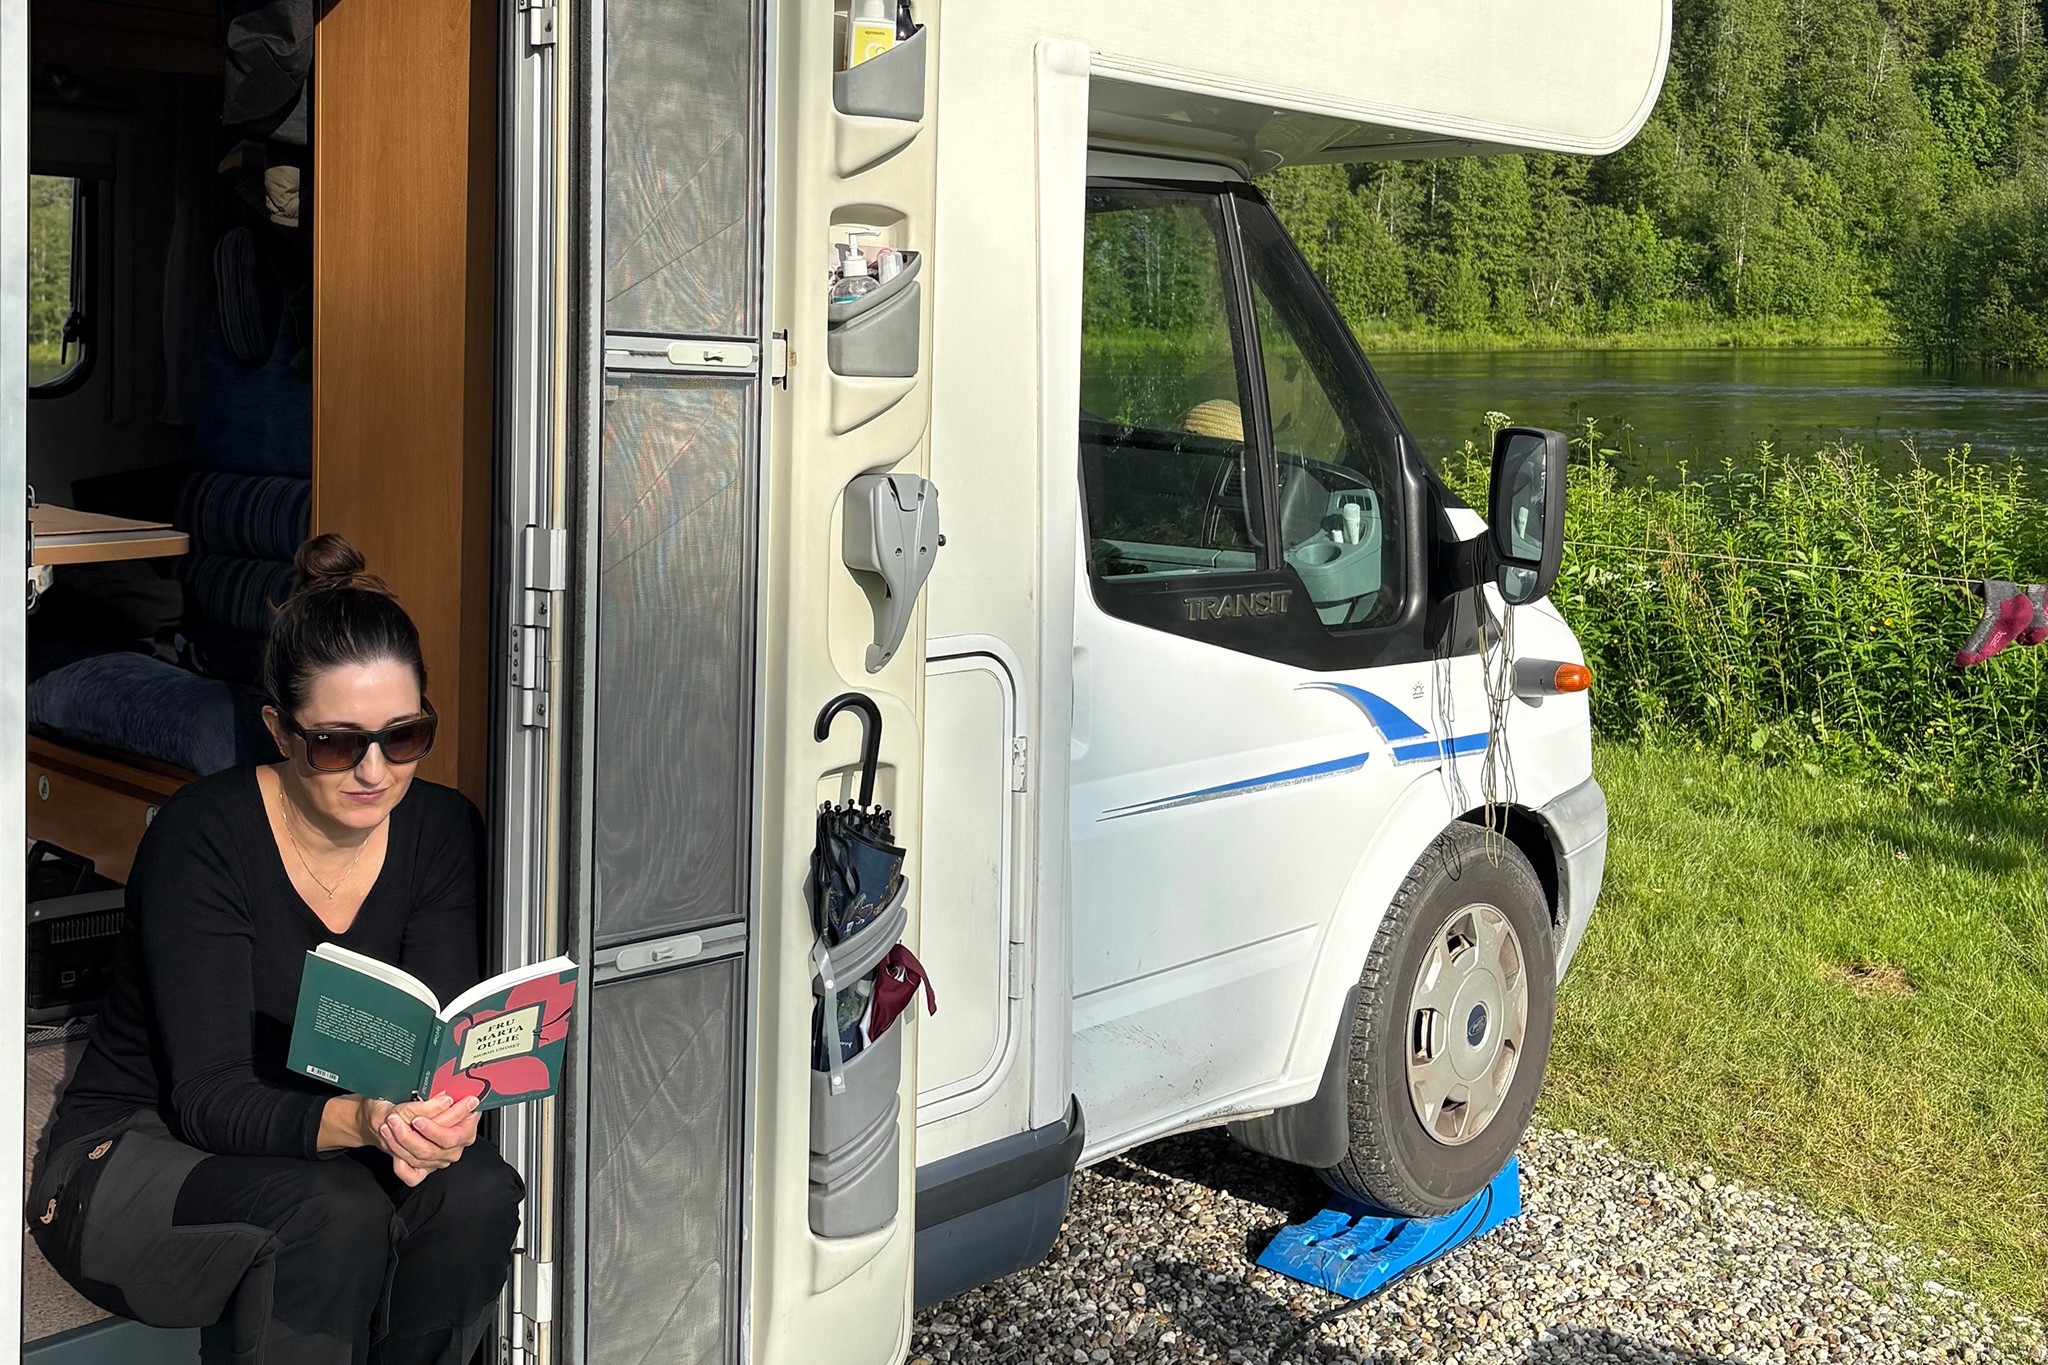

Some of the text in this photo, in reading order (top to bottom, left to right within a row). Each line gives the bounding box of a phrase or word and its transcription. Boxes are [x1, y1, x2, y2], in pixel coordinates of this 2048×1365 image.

[1184, 589, 1293, 622] TRANSIT
[487, 1018, 516, 1033] FRU
[476, 1025, 524, 1045] MARTA
[477, 1034, 520, 1051] OULIE
